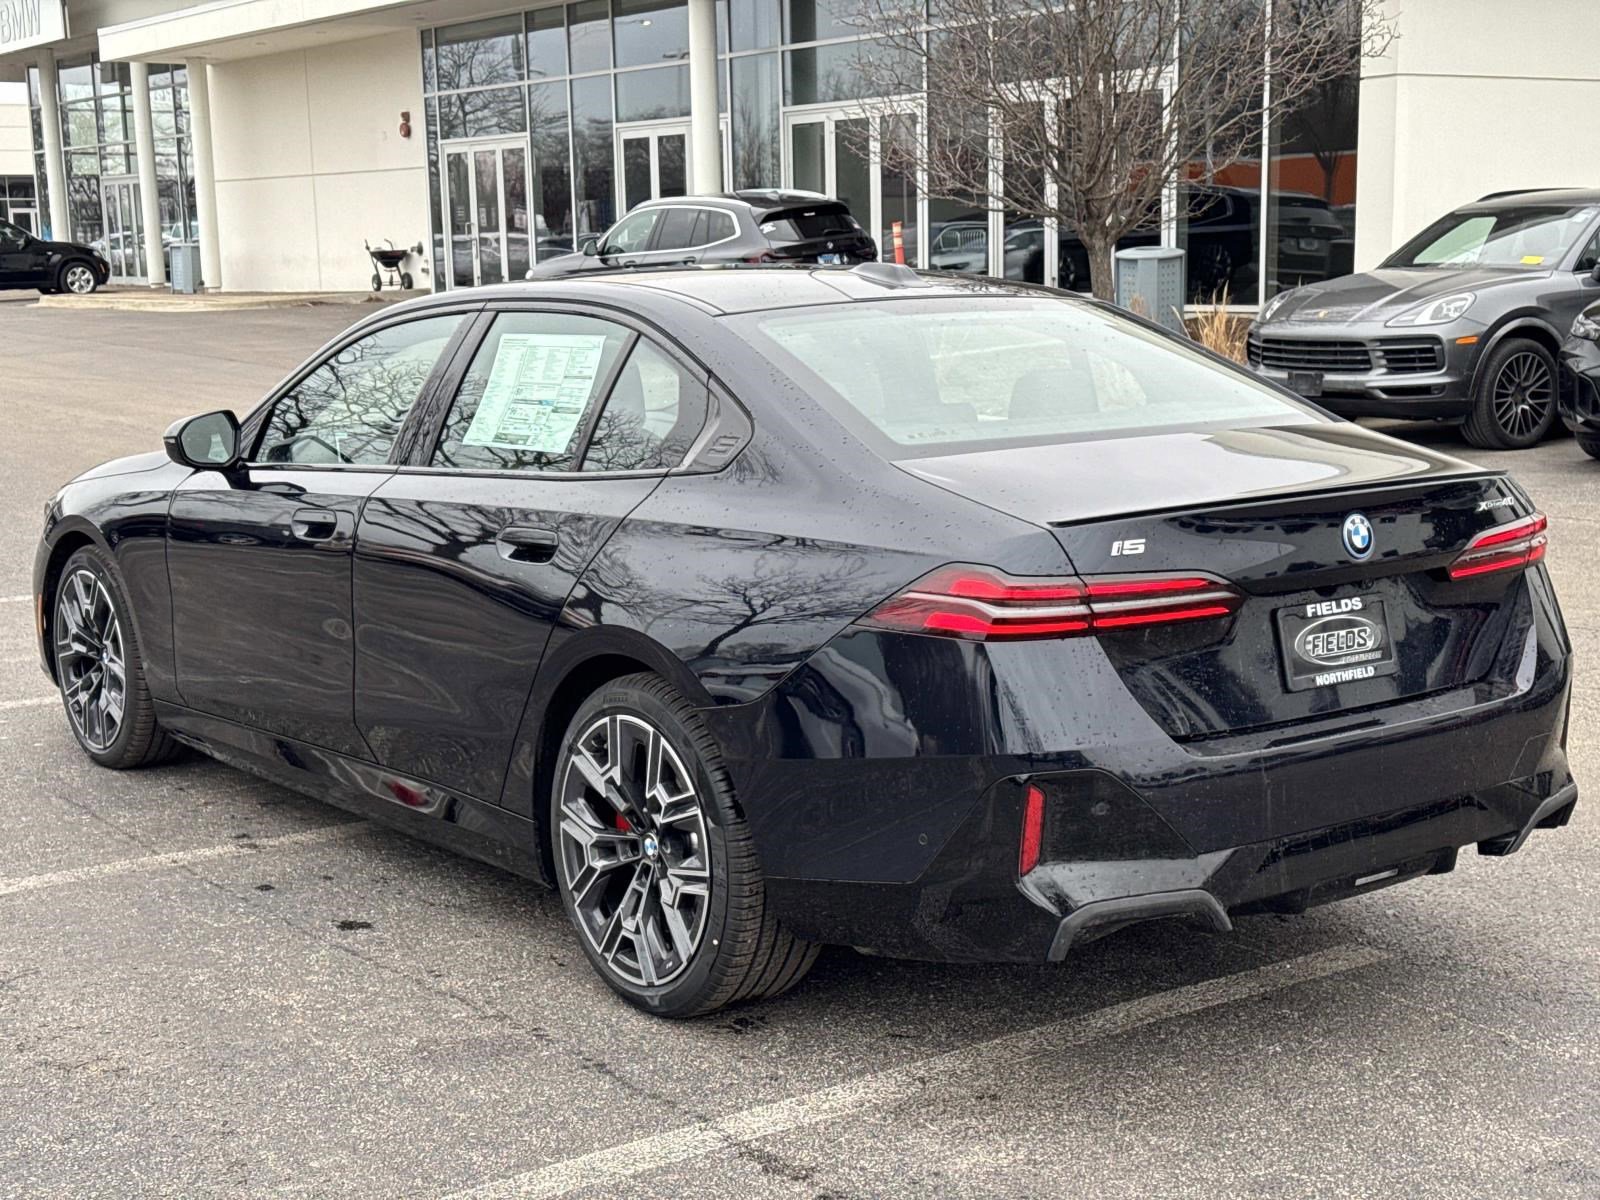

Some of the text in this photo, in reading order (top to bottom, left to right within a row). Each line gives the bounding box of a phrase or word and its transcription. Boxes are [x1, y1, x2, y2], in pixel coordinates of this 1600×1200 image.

[0, 0, 40, 44] BMW
[1111, 538, 1146, 556] i5
[1306, 597, 1363, 617] FIELDS
[1309, 627, 1370, 657] FIELDS
[1315, 666, 1375, 686] NORTHFIELD
